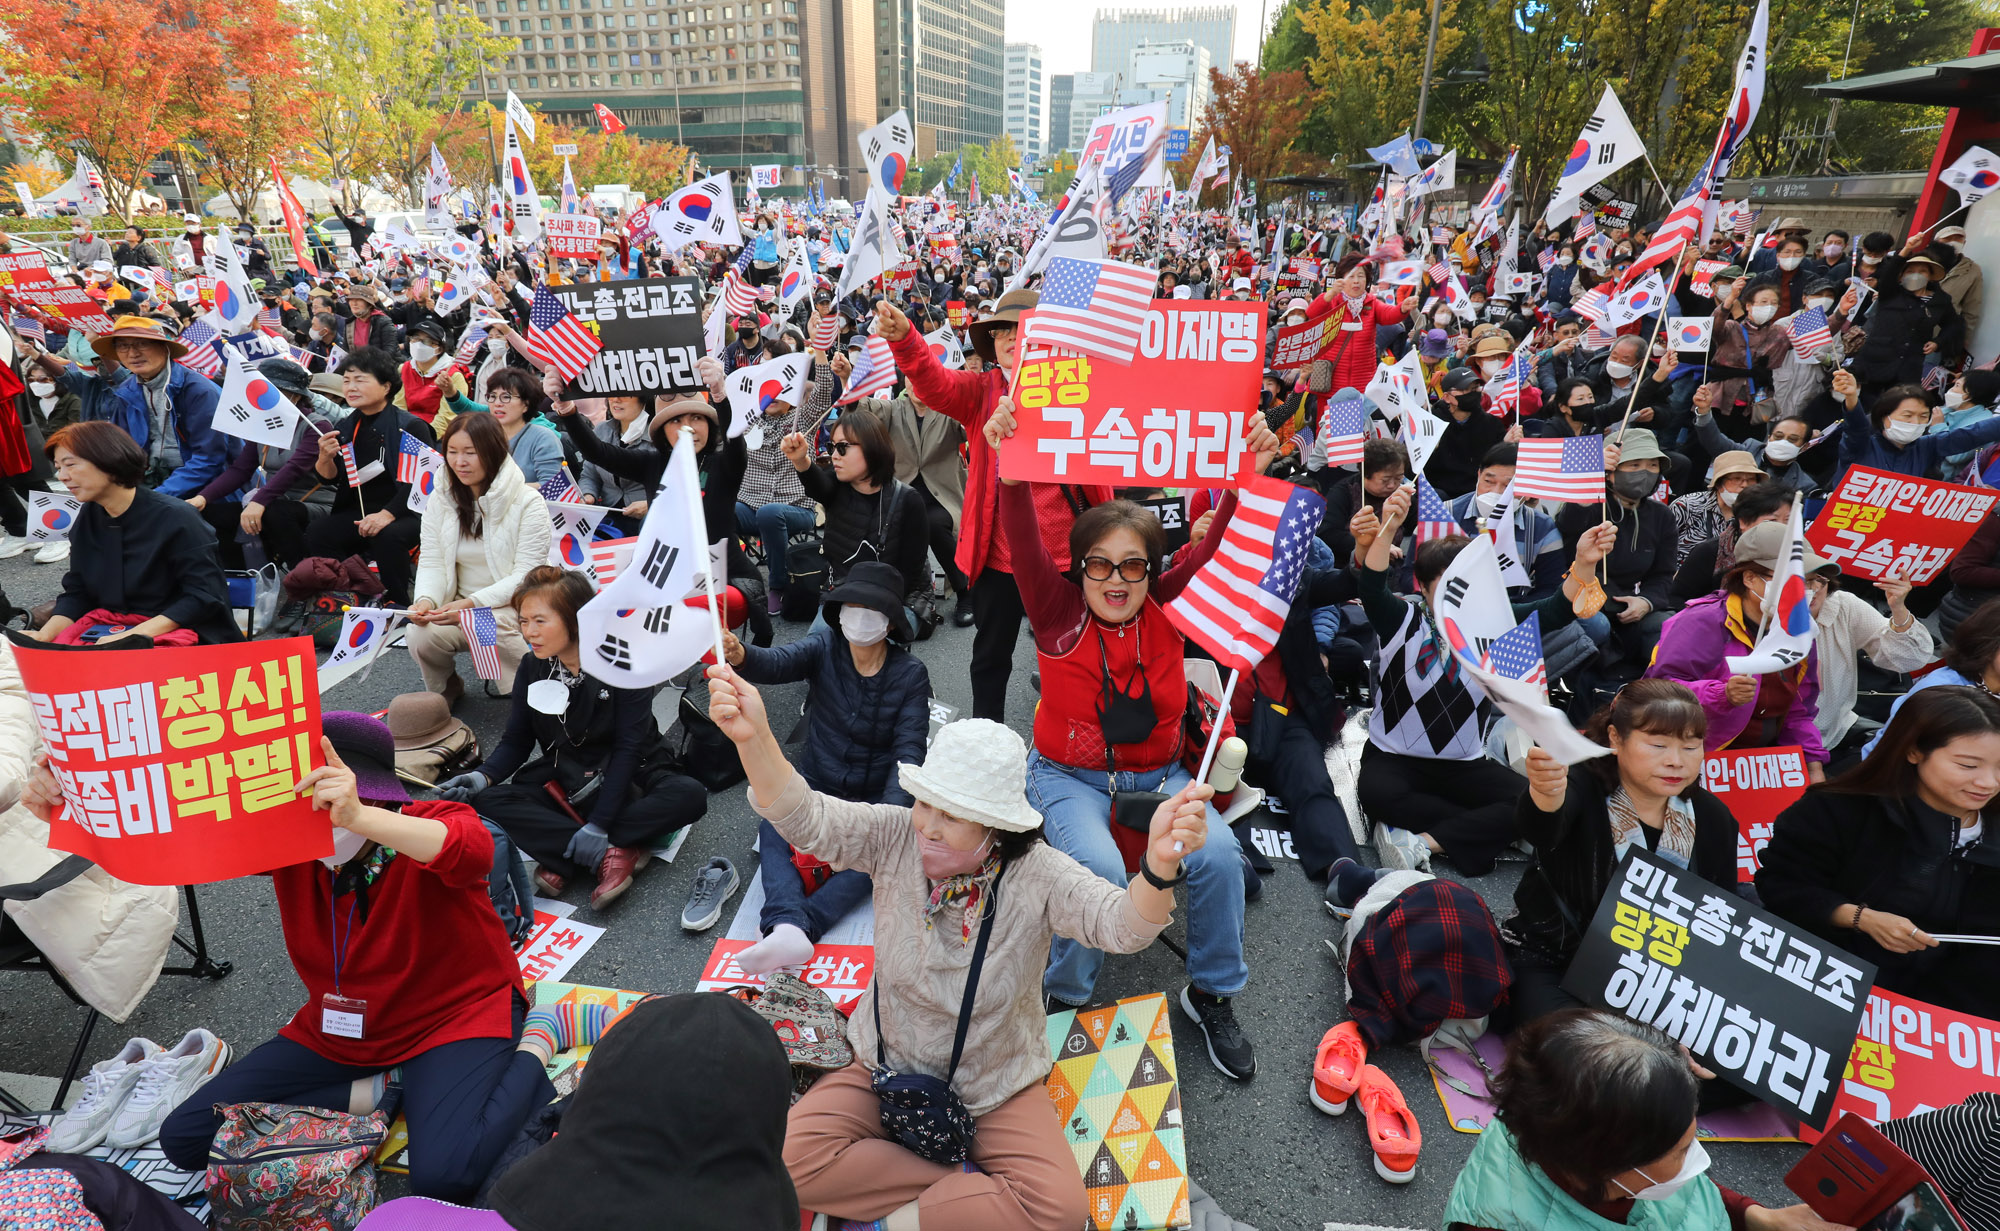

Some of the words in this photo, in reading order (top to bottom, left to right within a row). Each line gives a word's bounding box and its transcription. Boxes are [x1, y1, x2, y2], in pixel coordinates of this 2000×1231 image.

[1774, 184, 1791, 197] 시청
[548, 219, 573, 234] 주사파
[577, 219, 597, 235] 척결
[1277, 320, 1326, 353] 언론적폐
[1020, 357, 1092, 408] 당장
[1037, 407, 1248, 481] 구속하라
[1827, 502, 1887, 533] 당장
[1840, 471, 1996, 523] 문재인·이재명
[1821, 529, 1954, 583] 구속하라
[158, 654, 307, 749] 청산!
[166, 731, 314, 822] 박멸!
[1609, 900, 1691, 968] 당장
[1619, 856, 1864, 1014] 민노총·전교조
[711, 951, 865, 986] 자유로!
[1603, 949, 1832, 1116] 해체하라
[1857, 994, 2000, 1077] 재인·이
